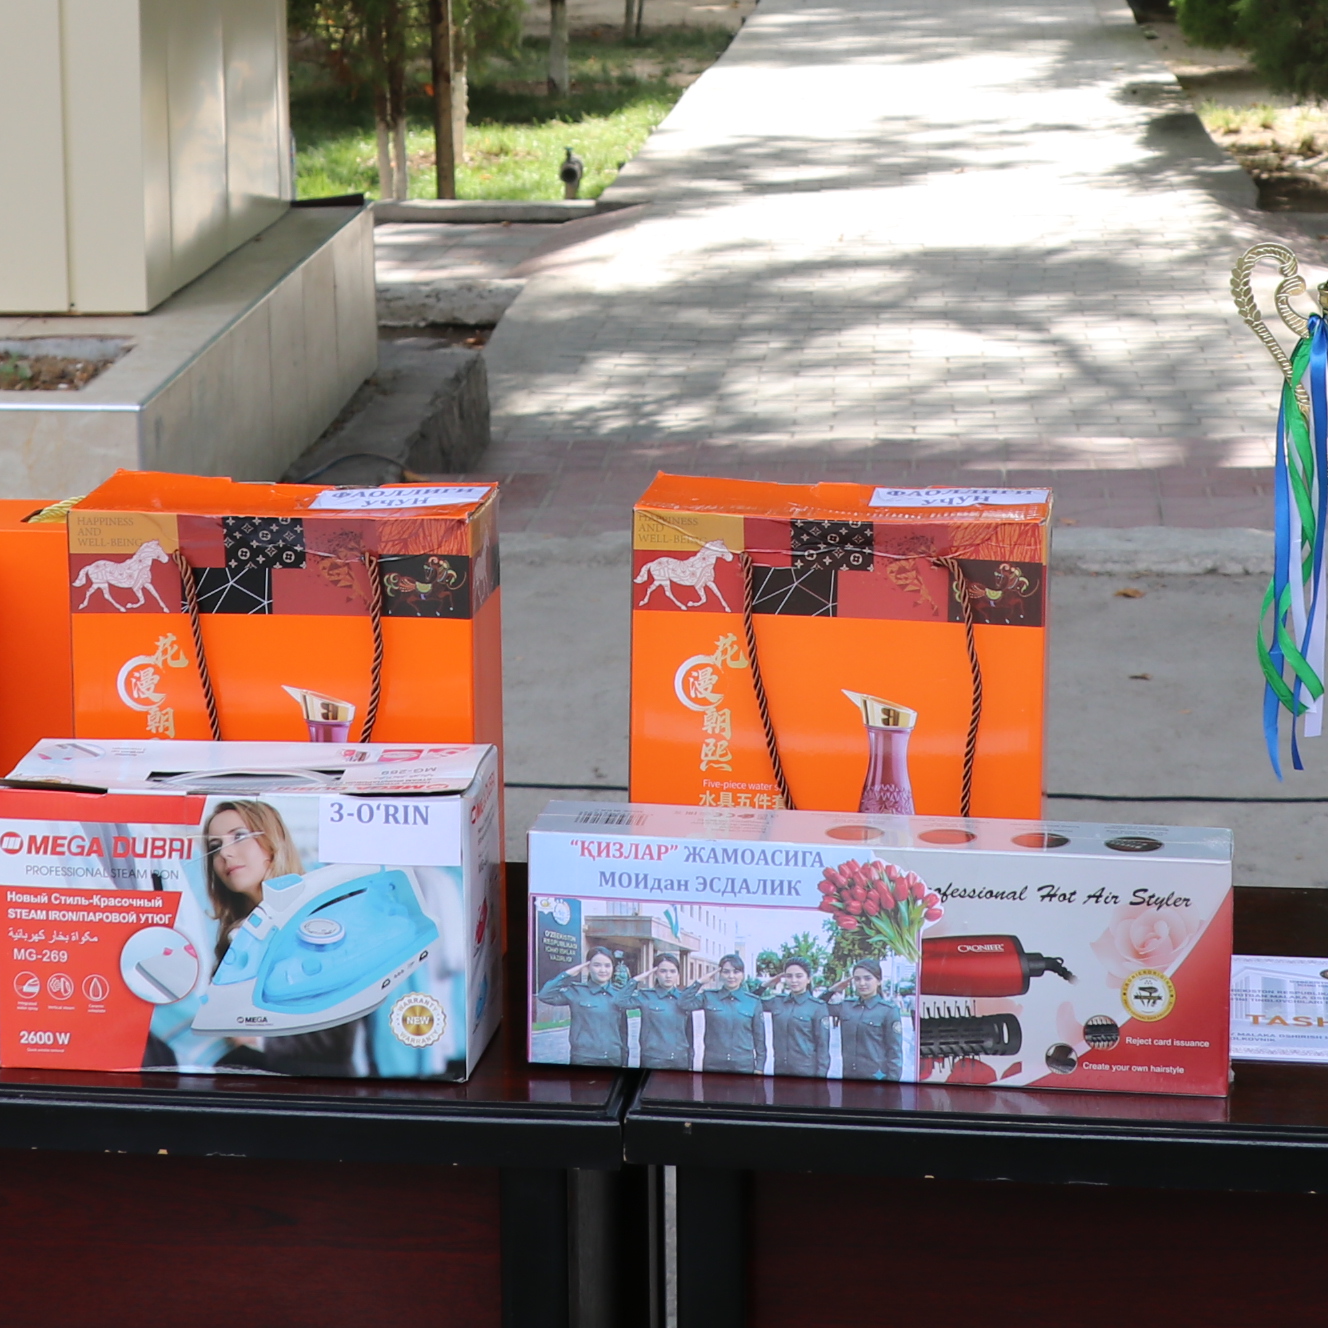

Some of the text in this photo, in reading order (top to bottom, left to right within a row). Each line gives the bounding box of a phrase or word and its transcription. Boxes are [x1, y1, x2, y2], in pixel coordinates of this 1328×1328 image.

[331, 487, 474, 498] ФАОЛЛИГИ
[360, 496, 430, 508] УЧУН
[921, 495, 991, 506] УЧУН
[77, 516, 134, 526] HAPPINESS
[77, 527, 102, 537] AND
[638, 523, 665, 533] AND
[77, 538, 143, 547] WELL-BEING
[131, 632, 190, 739] 花漫朝
[702, 778, 747, 790] Five-piece
[748, 782, 772, 790] water
[26, 835, 193, 860] MEGA DUBAI
[683, 845, 825, 868] ЖАМОАСИГА
[25, 865, 107, 878] PROFESSIONAL
[110, 867, 148, 880] STEAM
[598, 871, 802, 898] МОИдан ЭСДАЛИК
[6, 890, 163, 908] Новый Стиль-Красочный
[927, 882, 1193, 912] ofessional Hot Air Styler
[7, 908, 173, 925] STEAM IRON/ПАРОВОЙ УТЮГ
[957, 943, 1002, 953] CRONIER
[13, 948, 68, 963] MG-269
[406, 1016, 430, 1025] NEW
[19, 1031, 71, 1045] 2600 W
[1125, 1036, 1210, 1048] Reject card issuance
[1083, 1061, 1185, 1075] Create your own hairstyle
